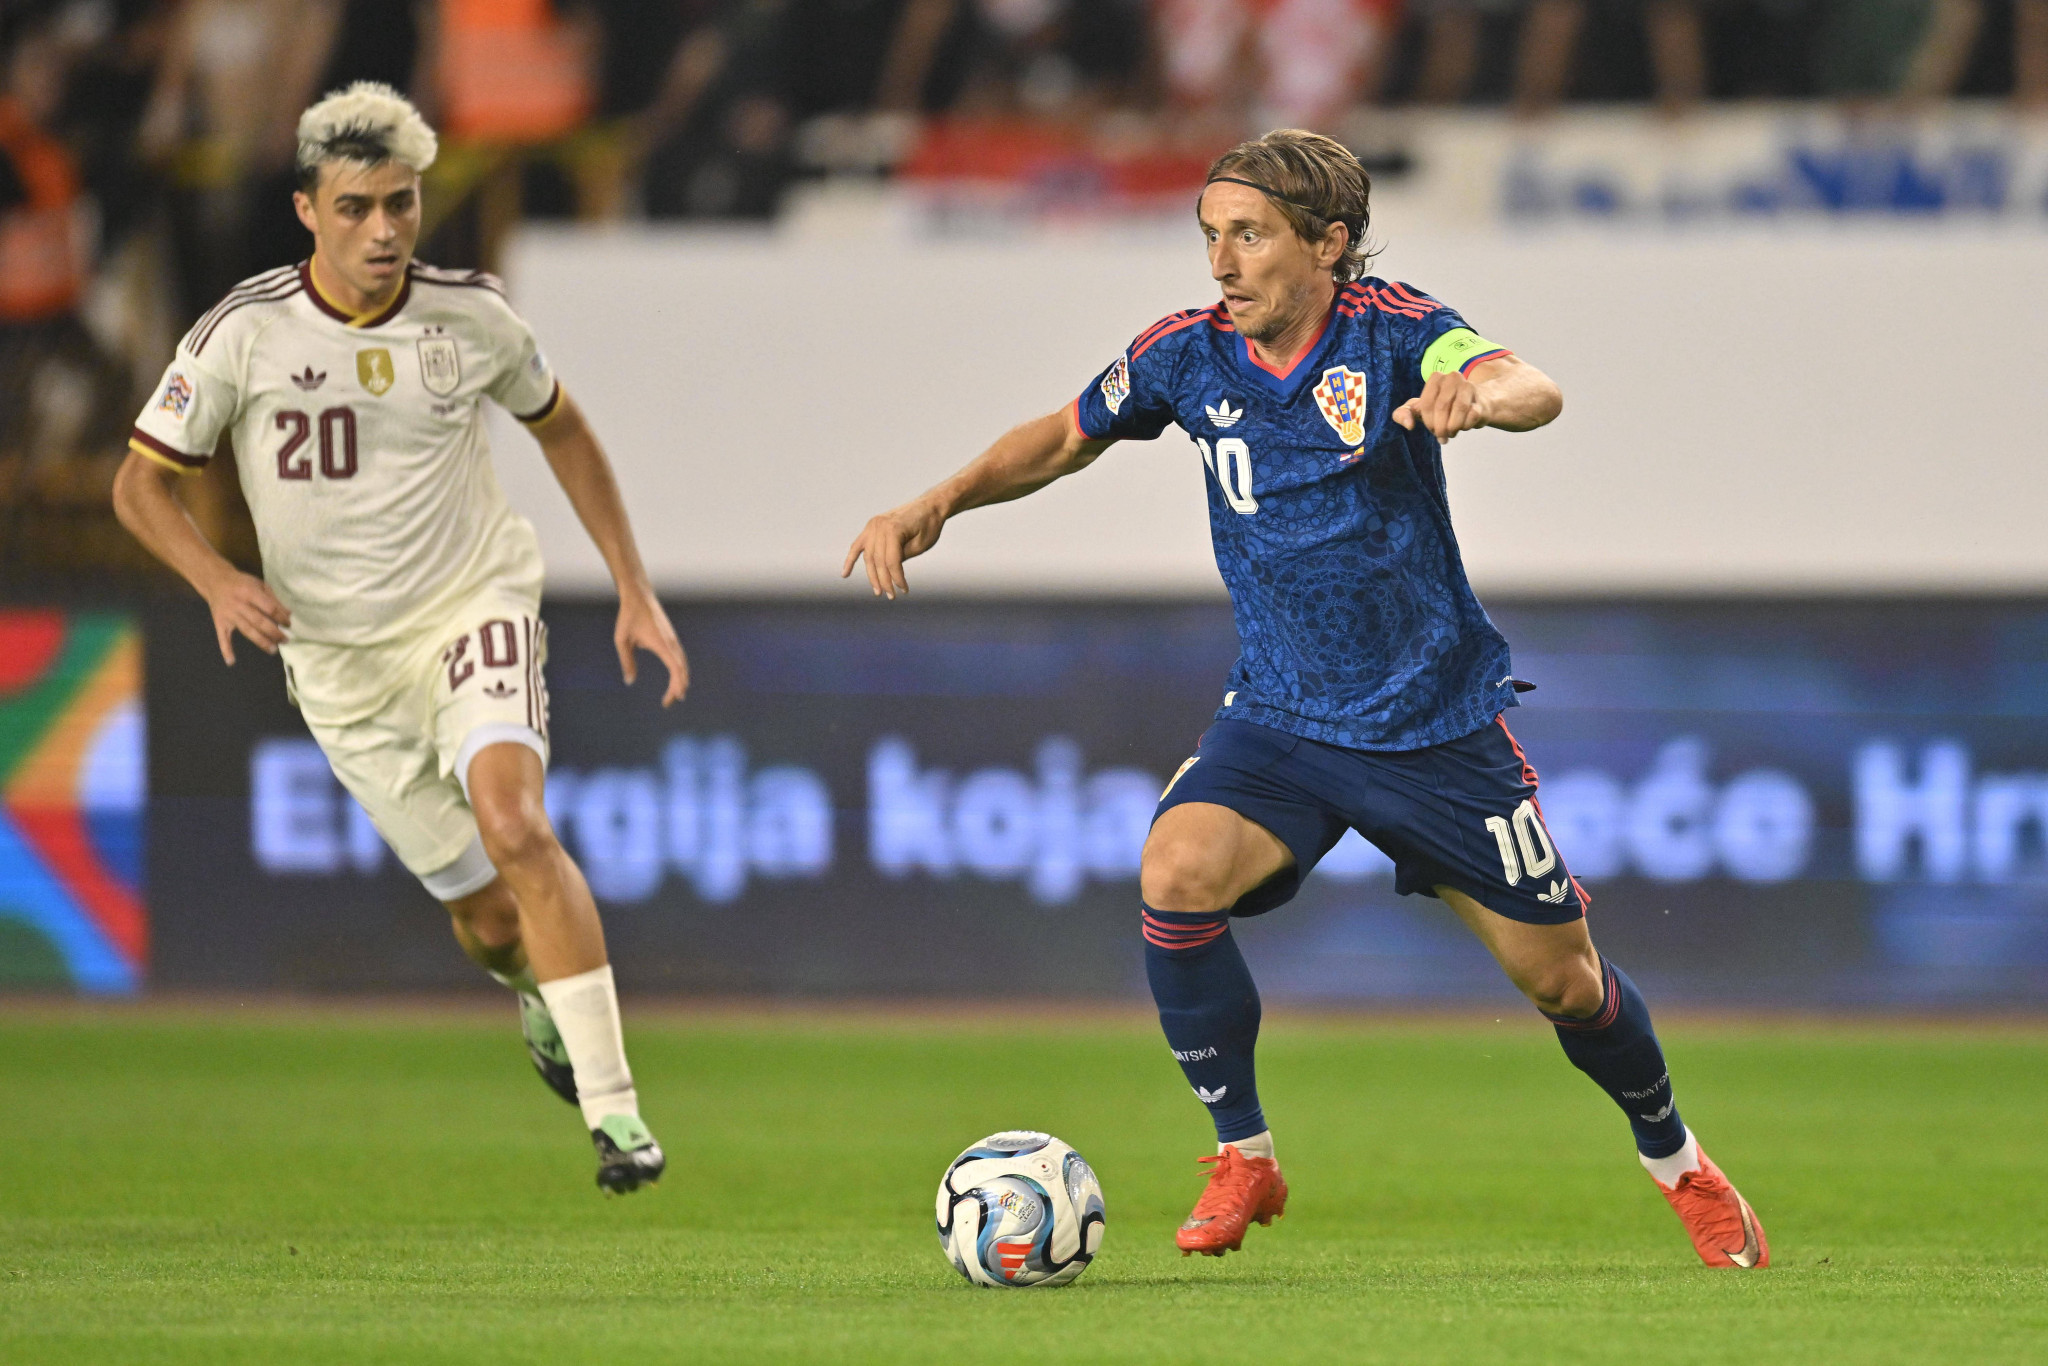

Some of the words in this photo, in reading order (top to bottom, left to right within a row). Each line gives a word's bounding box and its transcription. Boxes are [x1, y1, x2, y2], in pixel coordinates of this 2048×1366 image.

[1332, 376, 1348, 415] HNS
[275, 405, 358, 480] 20
[442, 618, 519, 694] 20
[1484, 799, 1556, 887] 10
